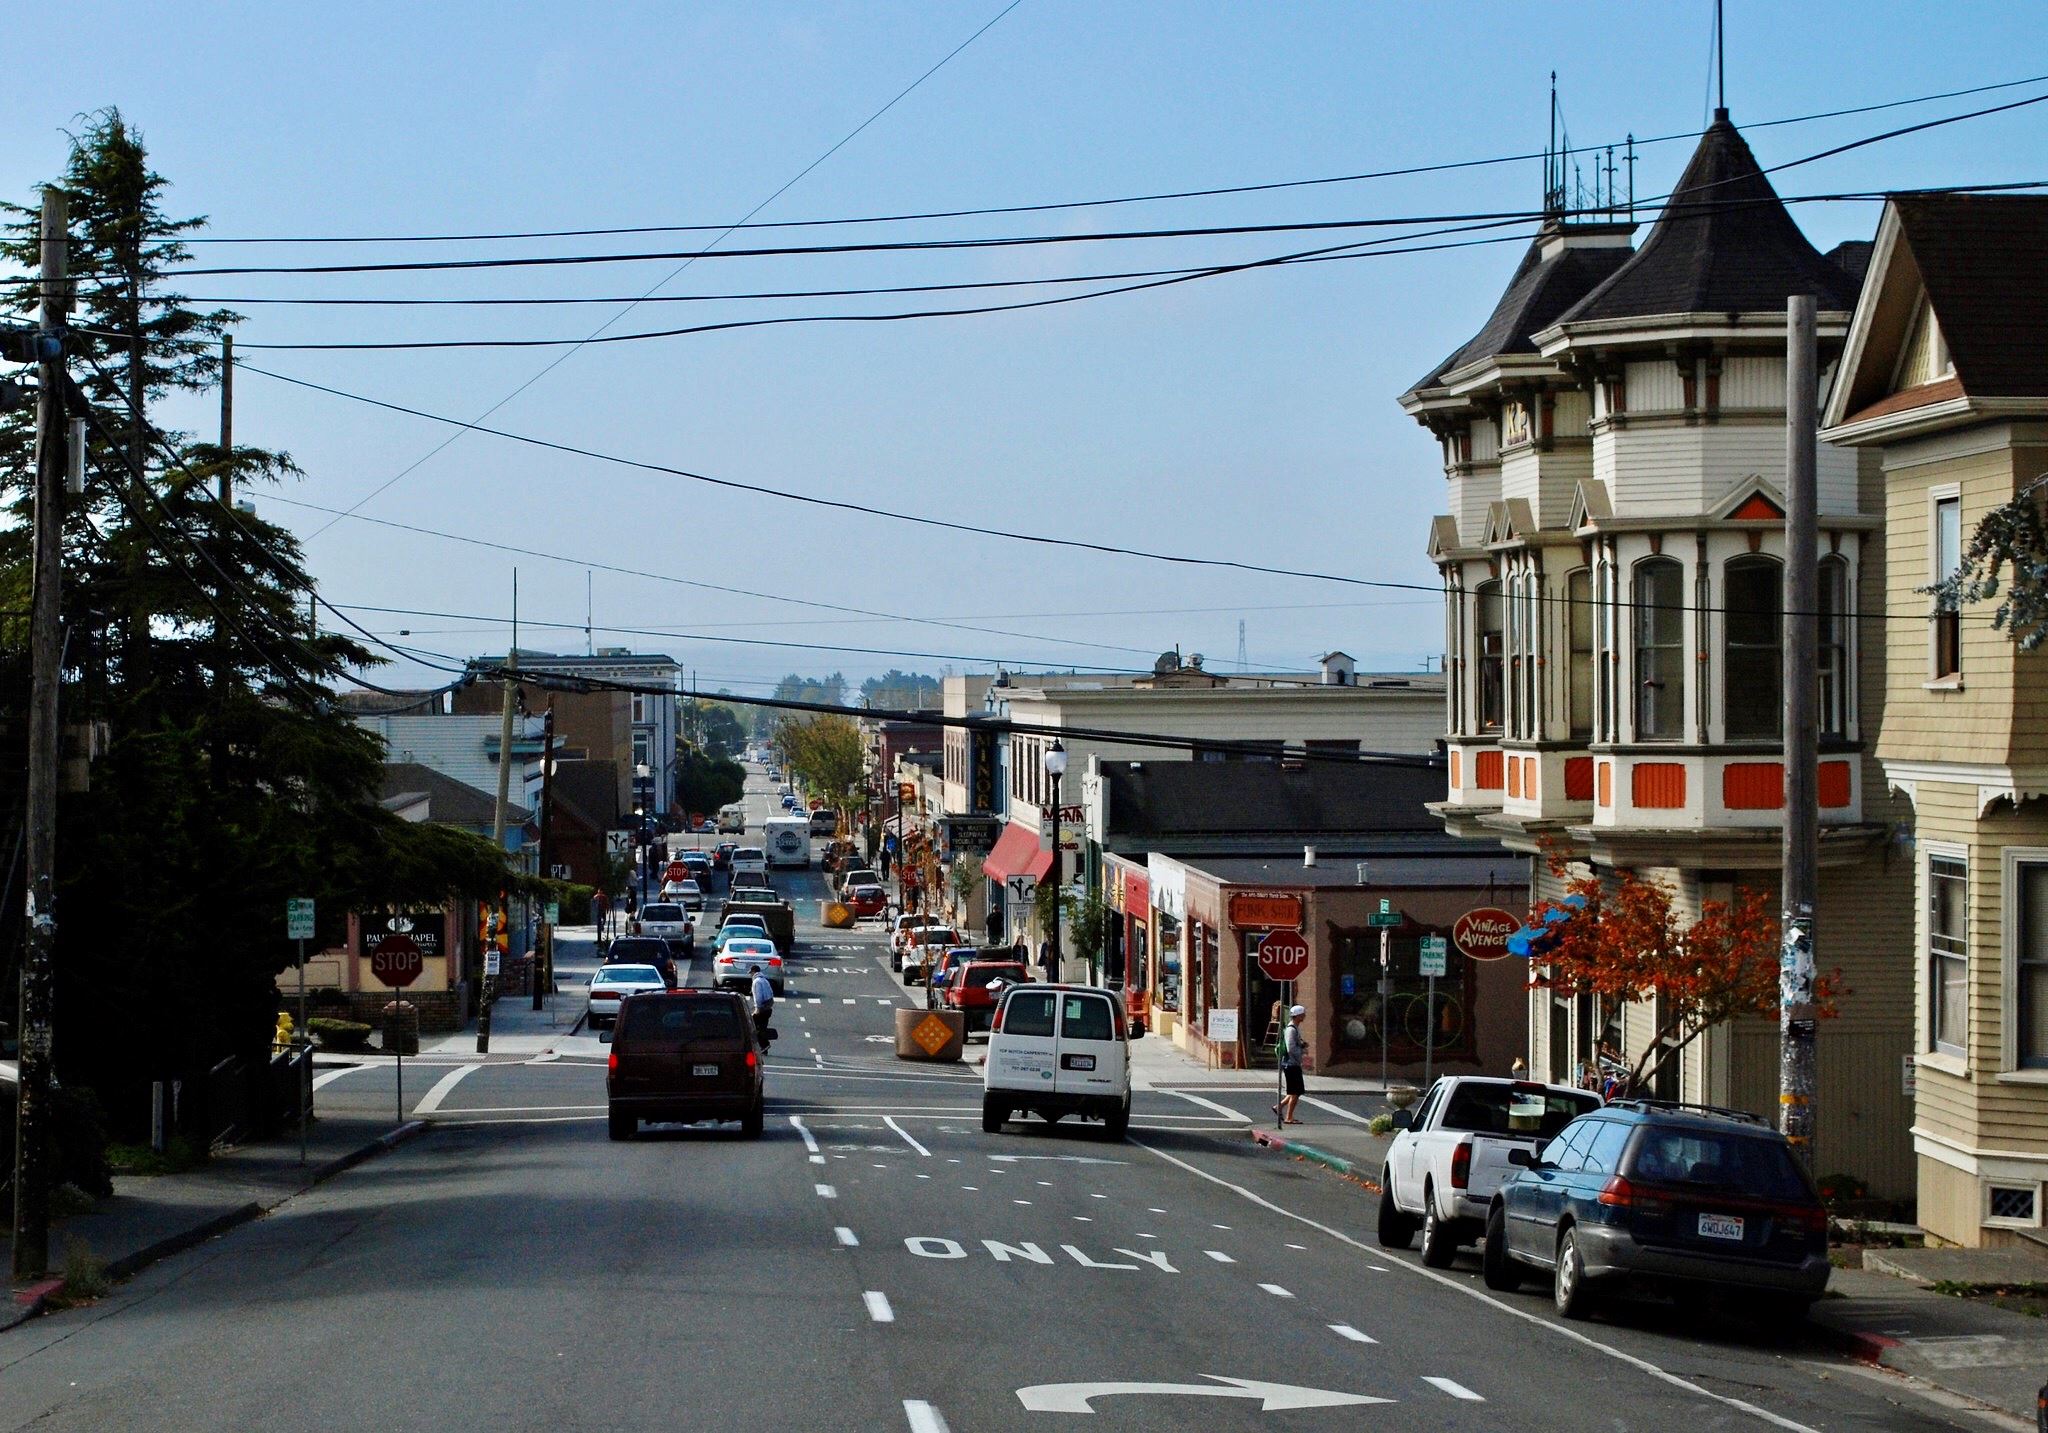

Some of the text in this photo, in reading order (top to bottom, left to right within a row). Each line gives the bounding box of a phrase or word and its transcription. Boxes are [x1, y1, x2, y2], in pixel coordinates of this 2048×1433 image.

[668, 867, 687, 876] STOP
[1466, 915, 1512, 934] VINTAGE
[1422, 940, 1429, 949] 2
[374, 952, 419, 971] STOP
[1262, 945, 1306, 965] STOP
[1422, 951, 1444, 959] PARKING
[803, 966, 868, 974] ONLY
[903, 1236, 1181, 1273] ONLY
